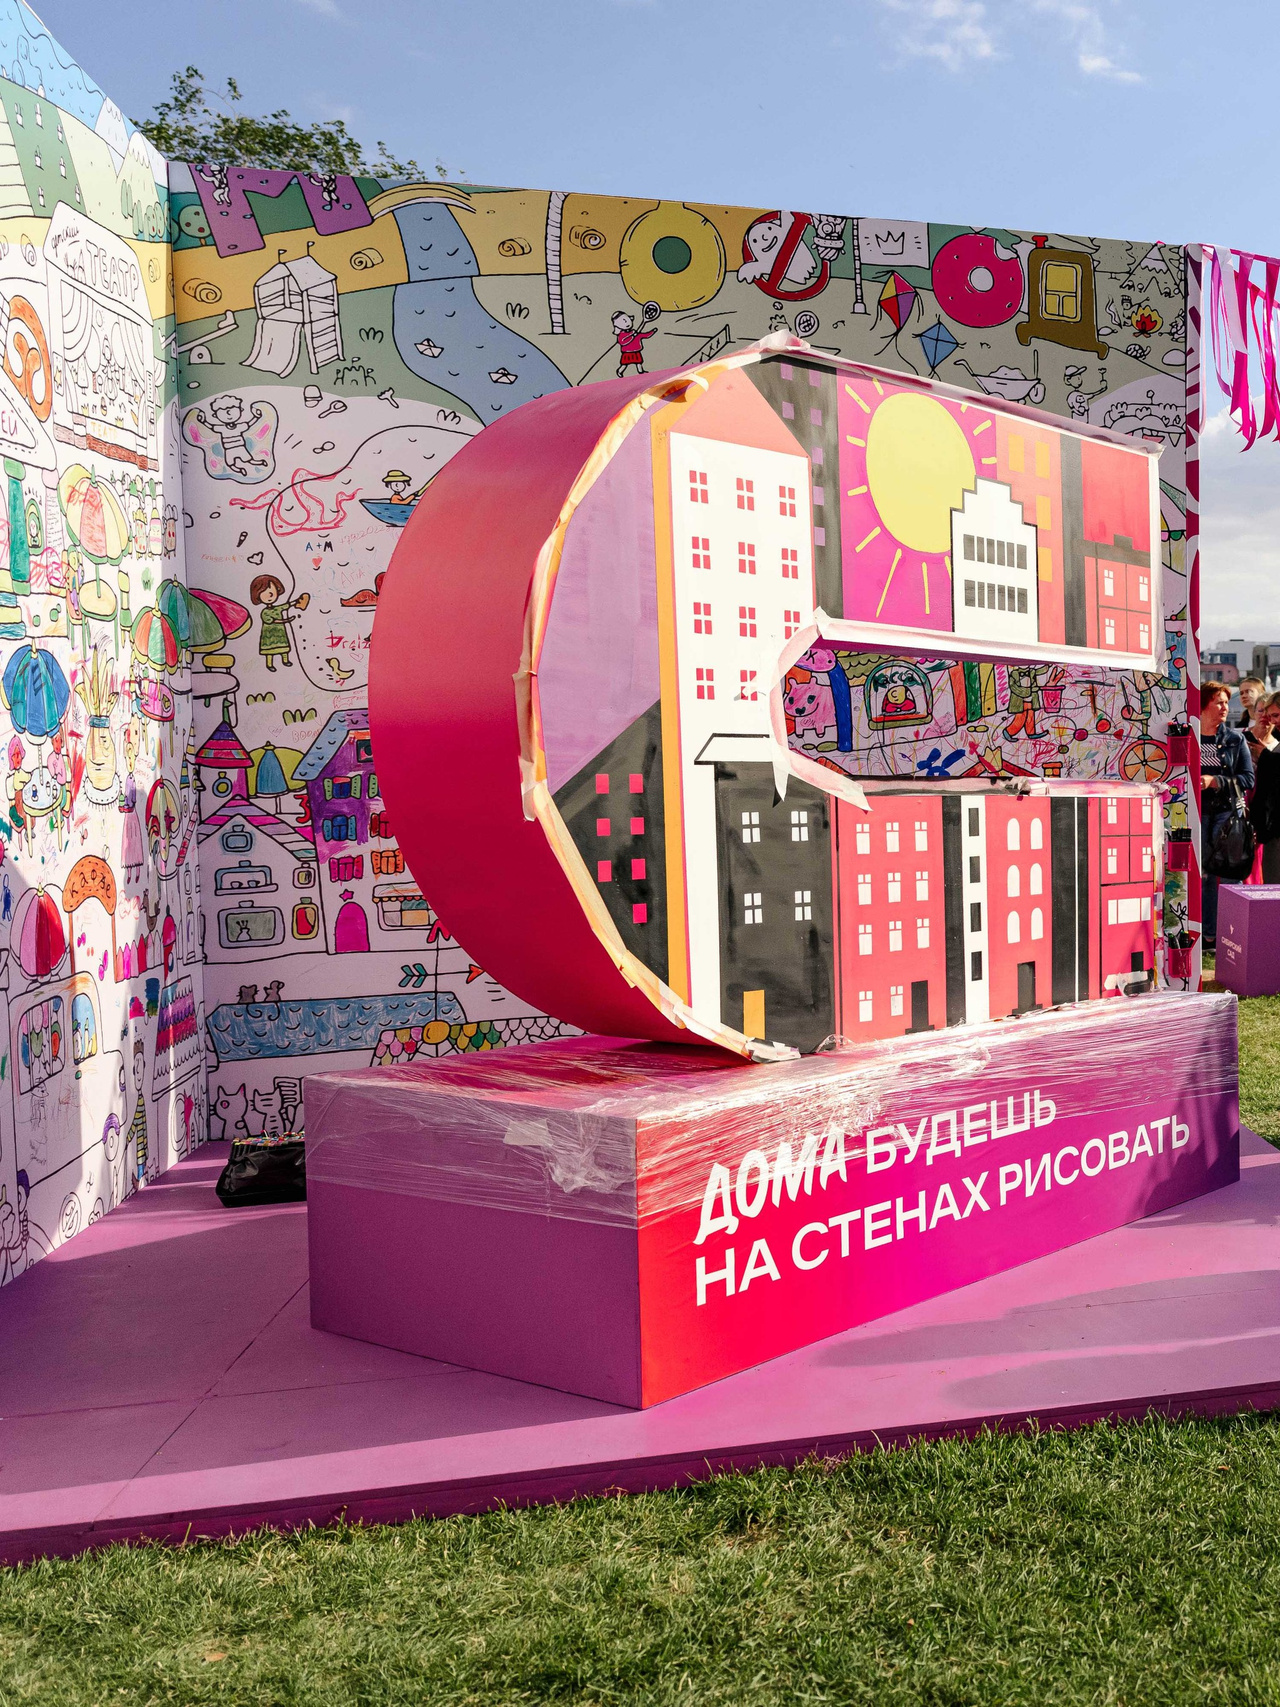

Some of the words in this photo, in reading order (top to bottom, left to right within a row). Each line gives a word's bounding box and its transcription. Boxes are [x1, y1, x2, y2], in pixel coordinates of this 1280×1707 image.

[692, 1123, 848, 1245] ДОМА
[866, 1089, 1057, 1174] БУДЕШЬ
[695, 1238, 782, 1307] НА
[791, 1171, 991, 1271] СТЕНАХ
[999, 1114, 1190, 1206] РИСОВАТЬ
